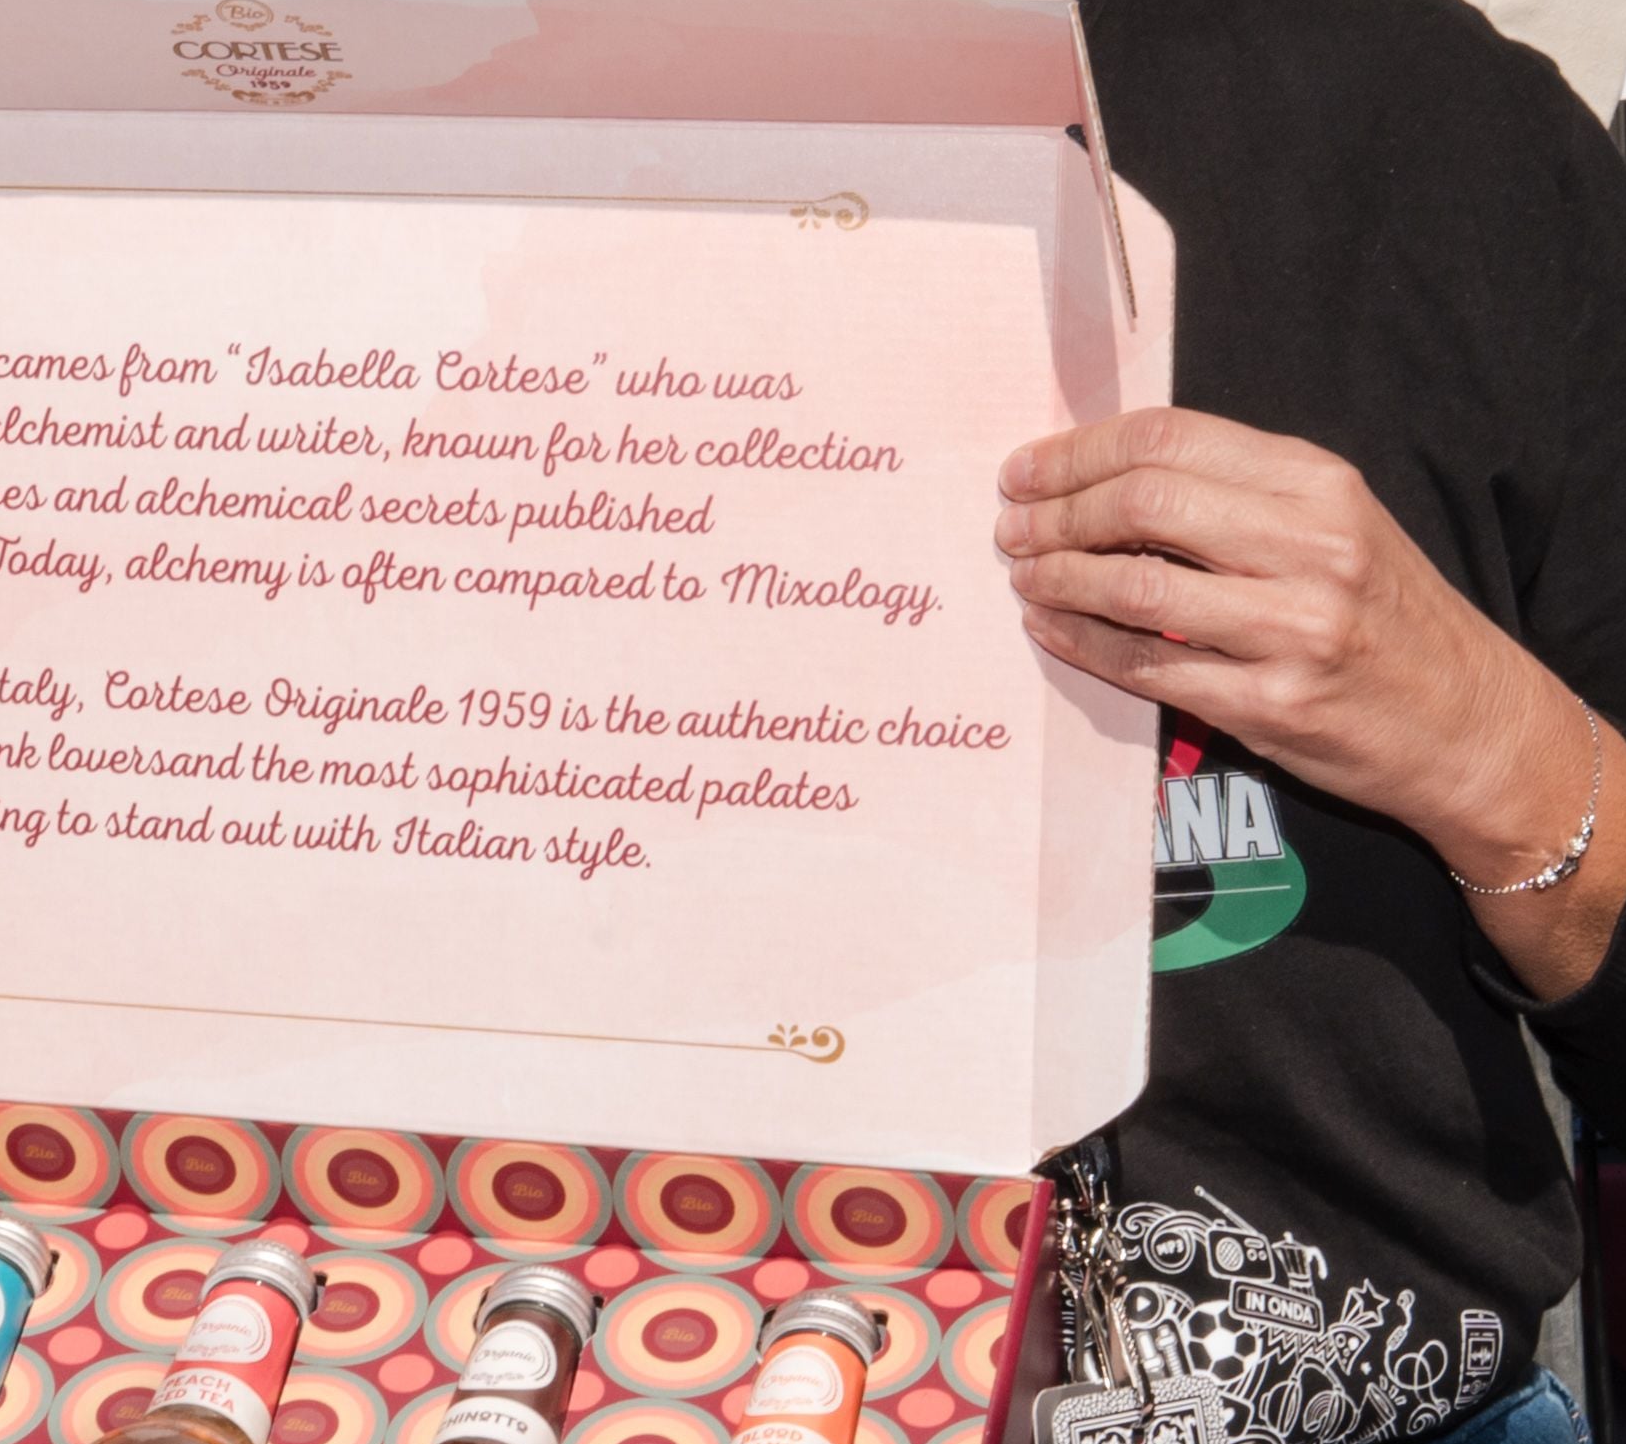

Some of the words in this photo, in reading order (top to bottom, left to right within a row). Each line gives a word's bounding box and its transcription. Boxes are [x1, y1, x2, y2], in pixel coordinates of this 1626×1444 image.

[172, 40, 344, 62] CORTESE
[215, 63, 317, 81] Originale
[249, 79, 292, 91] 1959
[119, 342, 218, 398] from
[227, 342, 422, 392] “Isabella
[436, 351, 607, 394] Cortese”
[616, 357, 706, 397] who
[713, 373, 802, 400] was
[174, 413, 251, 451] and
[257, 416, 390, 462] writer,
[402, 417, 539, 461] known
[543, 422, 610, 477] for
[616, 424, 688, 465] her
[695, 427, 903, 472] collection
[54, 475, 129, 513] and
[135, 477, 352, 521] alchemical
[360, 488, 507, 527] secrets
[508, 490, 715, 543] published
[123, 541, 295, 603] alchemy
[297, 552, 336, 589] is
[340, 550, 448, 606] often
[452, 559, 656, 611] compared
[660, 563, 706, 603] to
[720, 561, 945, 629] Mixology.
[105, 670, 251, 715] Cortese
[265, 677, 448, 735] Originale
[457, 687, 552, 730] 1959
[559, 695, 598, 733] is
[604, 694, 669, 736] the
[677, 700, 869, 744] authentic
[877, 706, 1011, 750] choice
[252, 744, 314, 783] the
[319, 752, 419, 789] most
[426, 755, 694, 808] sophisticated
[696, 768, 859, 820] palates
[57, 799, 98, 836] to
[105, 803, 214, 843] stand
[222, 811, 287, 847] out
[293, 814, 381, 853] with
[393, 816, 536, 862] Italian
[544, 827, 650, 881] style.
[1155, 1239, 1184, 1256] MP3
[1245, 1290, 1268, 1312] IN
[1267, 1295, 1316, 1325] ONDA
[166, 1373, 232, 1393] PEACH
[197, 1389, 236, 1414] TEA
[739, 1427, 803, 1444] BLOOD
